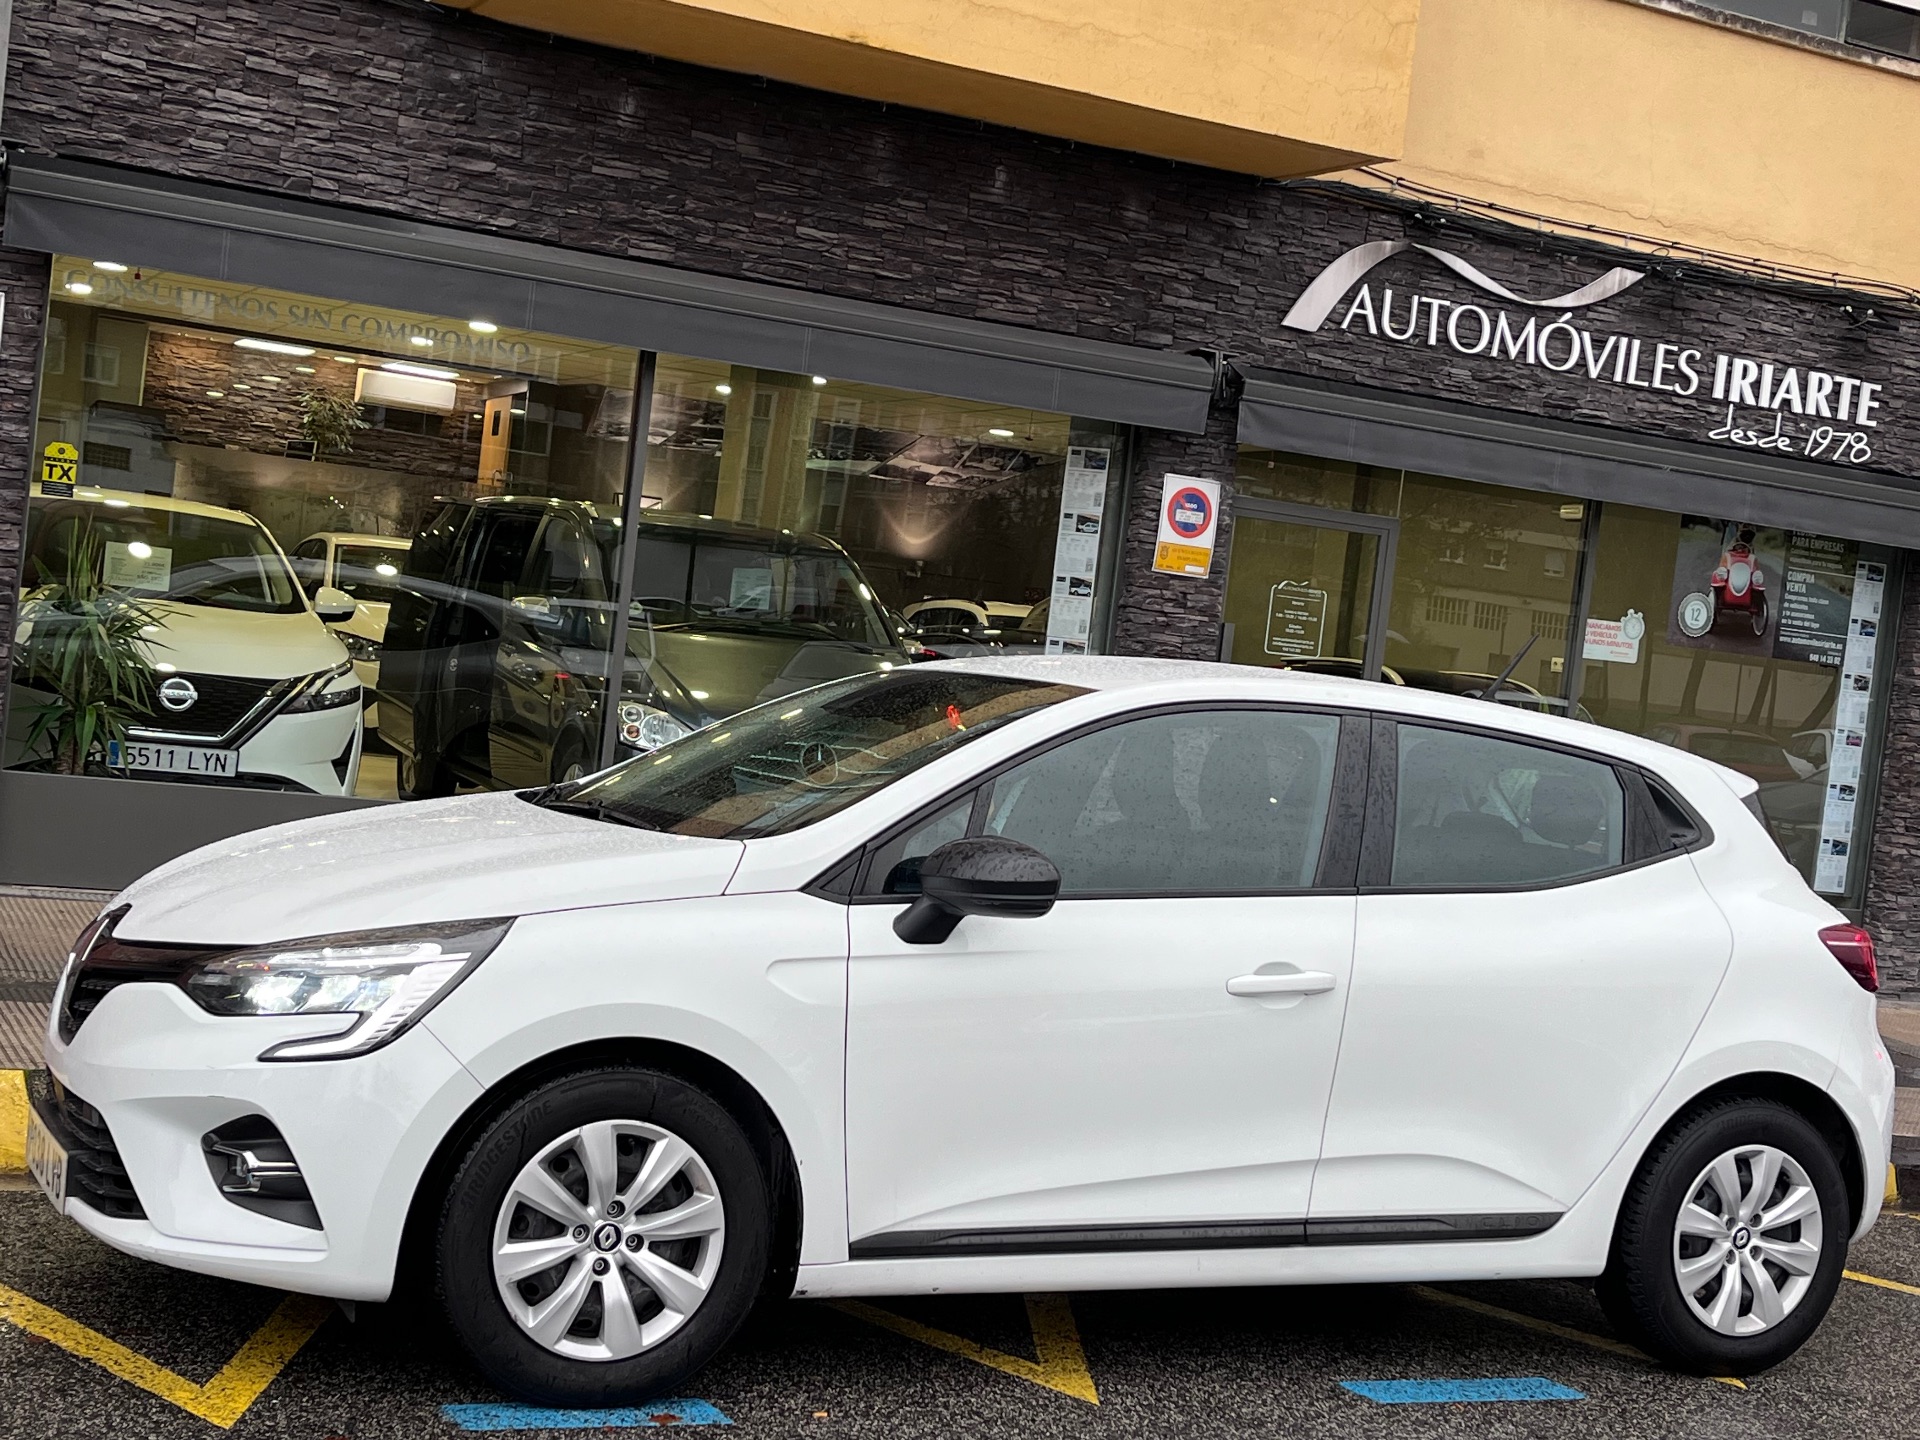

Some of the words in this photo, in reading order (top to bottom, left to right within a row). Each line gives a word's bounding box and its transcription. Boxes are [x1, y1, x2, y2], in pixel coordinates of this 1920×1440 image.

[288, 304, 333, 330] SIN
[341, 313, 529, 363] COMPROMISO
[1340, 283, 1701, 396] AUTOMÓVILES
[1712, 354, 1882, 427] IRIARTE
[1708, 403, 1793, 452] desde
[1804, 426, 1871, 463] 1978
[45, 463, 74, 482] TX
[1810, 539, 1845, 553] EMPRESAS
[1787, 571, 1815, 584] COMPRA
[1786, 581, 1806, 594] VENTA
[1691, 607, 1701, 621] 12
[162, 690, 194, 699] NISSAN
[126, 746, 175, 769] 5511
[188, 751, 228, 773] LYN
